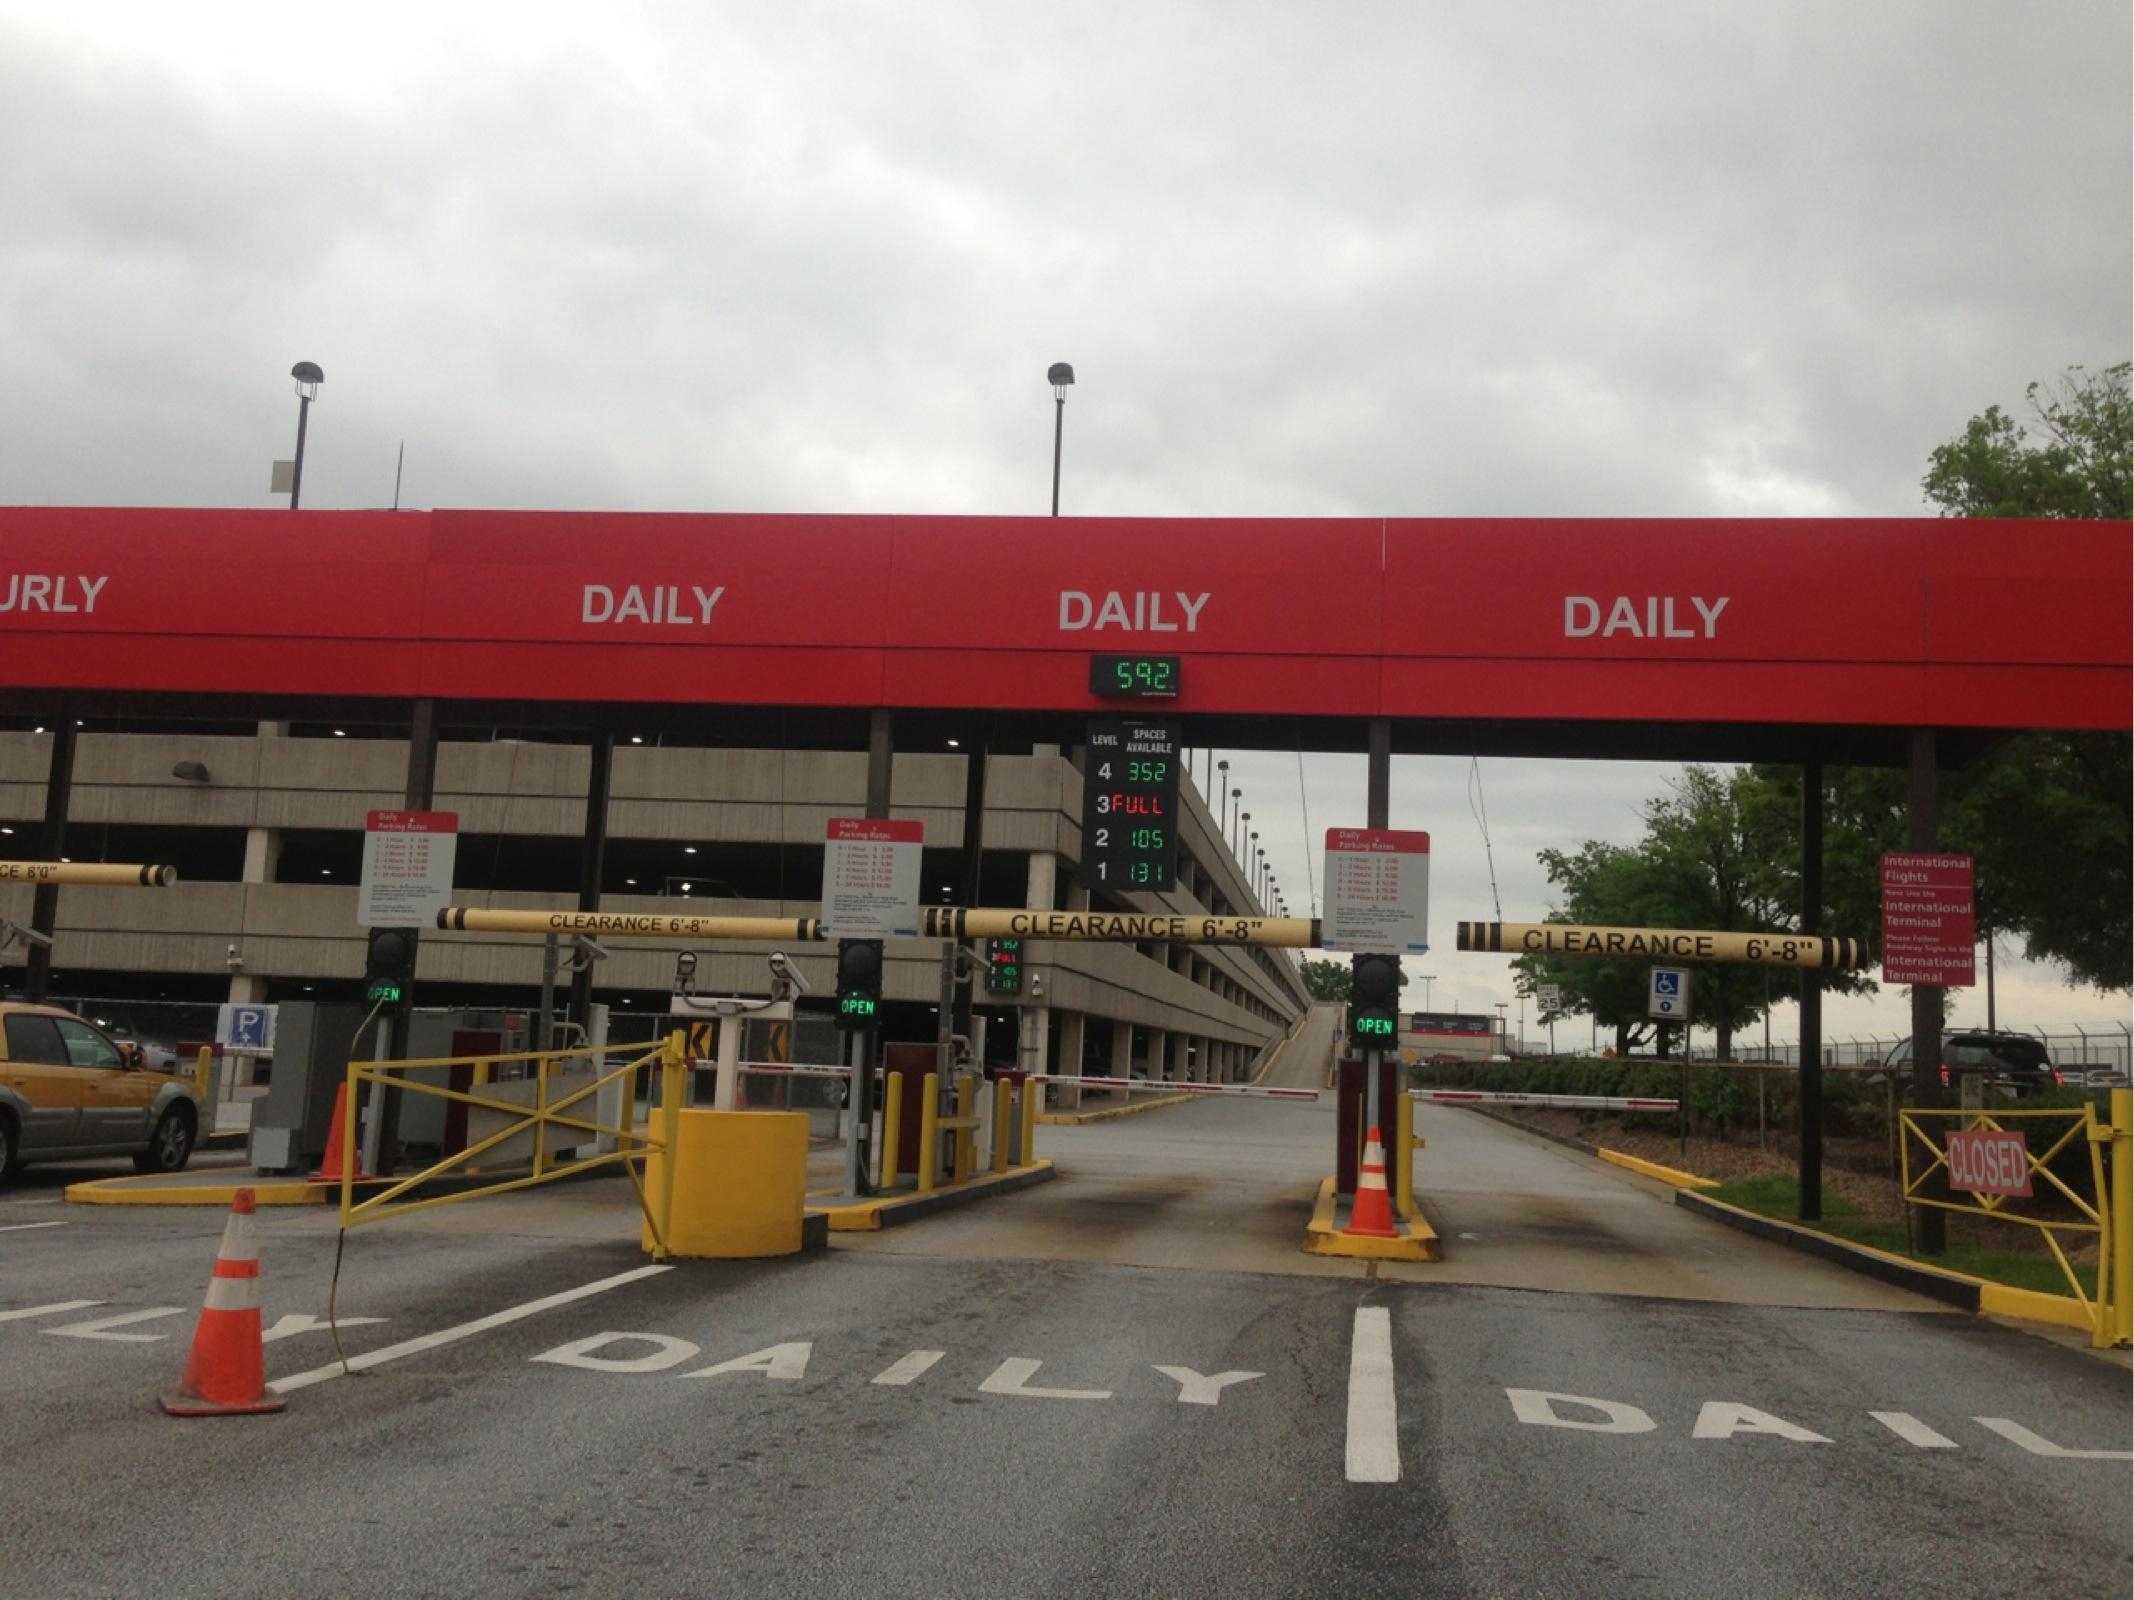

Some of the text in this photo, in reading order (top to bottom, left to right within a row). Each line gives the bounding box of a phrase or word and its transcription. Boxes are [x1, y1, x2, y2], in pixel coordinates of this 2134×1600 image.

[581, 585, 725, 624] DAILY
[1058, 590, 1211, 633] DAILY
[1563, 596, 1729, 638] DAILY
[1117, 661, 1170, 689] 592
[1092, 734, 1118, 746] LEVEL
[1133, 729, 1166, 740] SPACES
[1126, 742, 1173, 754] AVAILABLE
[1098, 762, 1166, 782] 4 352
[1097, 794, 1164, 815] 3 FULL
[1095, 829, 1164, 849] 2 105
[0, 864, 20, 878] CE
[1884, 856, 1971, 869] International
[1097, 862, 1163, 883] 1 131
[1885, 870, 1928, 884] Flights
[1886, 901, 1971, 913] International
[549, 914, 709, 933] CLEARANCE 6'-8"
[1010, 914, 1262, 940] CLEARANCE 6'-8"
[1886, 915, 1942, 928] Terminal
[1522, 929, 1813, 962] CLEARANCE 6'-8"
[1886, 955, 1972, 968] International
[1887, 970, 1943, 982] Terminal
[367, 986, 400, 1001] OPEN
[841, 999, 875, 1016] OPEN
[1540, 997, 1558, 1009] 25
[239, 1011, 259, 1032] P
[1356, 1017, 1393, 1034] OPEN
[1949, 1136, 2026, 1188] CLOSED
[528, 1331, 1267, 1405] DAILY
